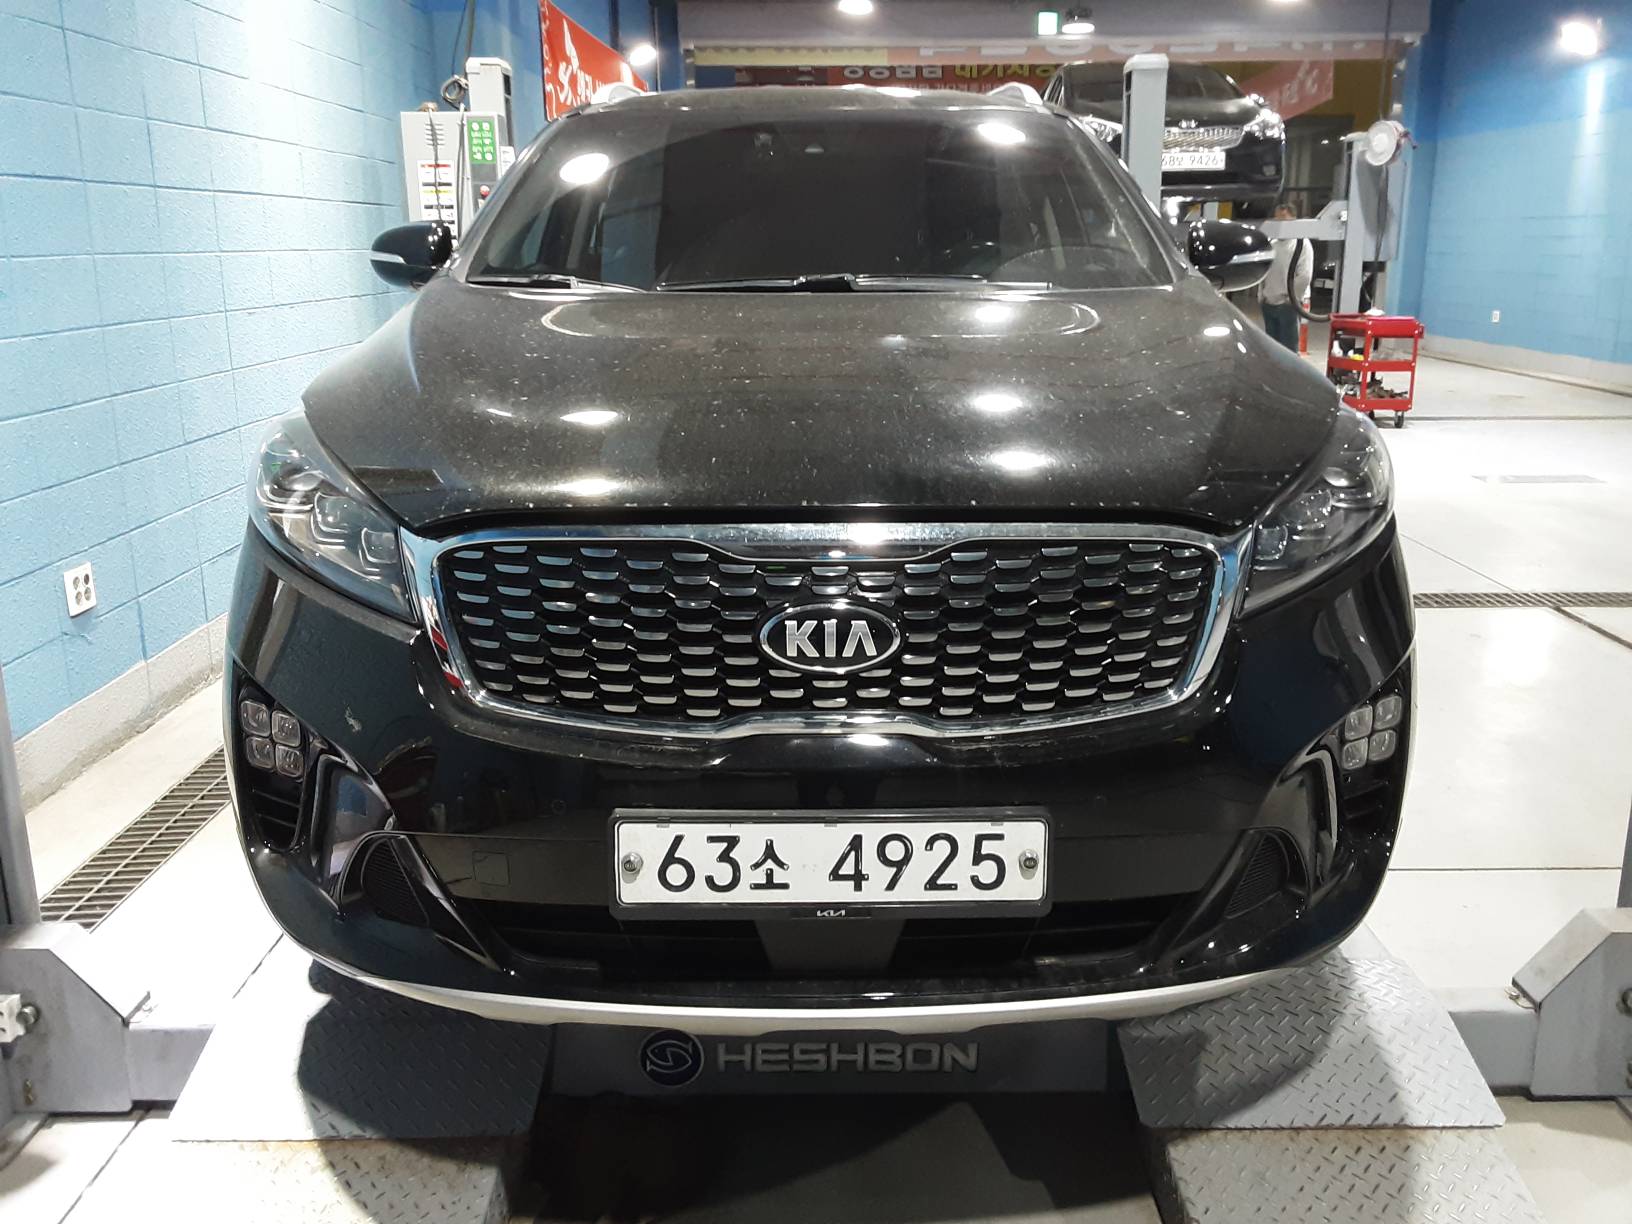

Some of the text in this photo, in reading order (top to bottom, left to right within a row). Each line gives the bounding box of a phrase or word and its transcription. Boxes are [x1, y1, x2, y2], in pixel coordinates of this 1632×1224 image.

[1189, 154, 1219, 166] 9426
[784, 618, 878, 658] KIA
[656, 832, 1007, 893] 63소 4925
[717, 1041, 981, 1073] HESHBON
